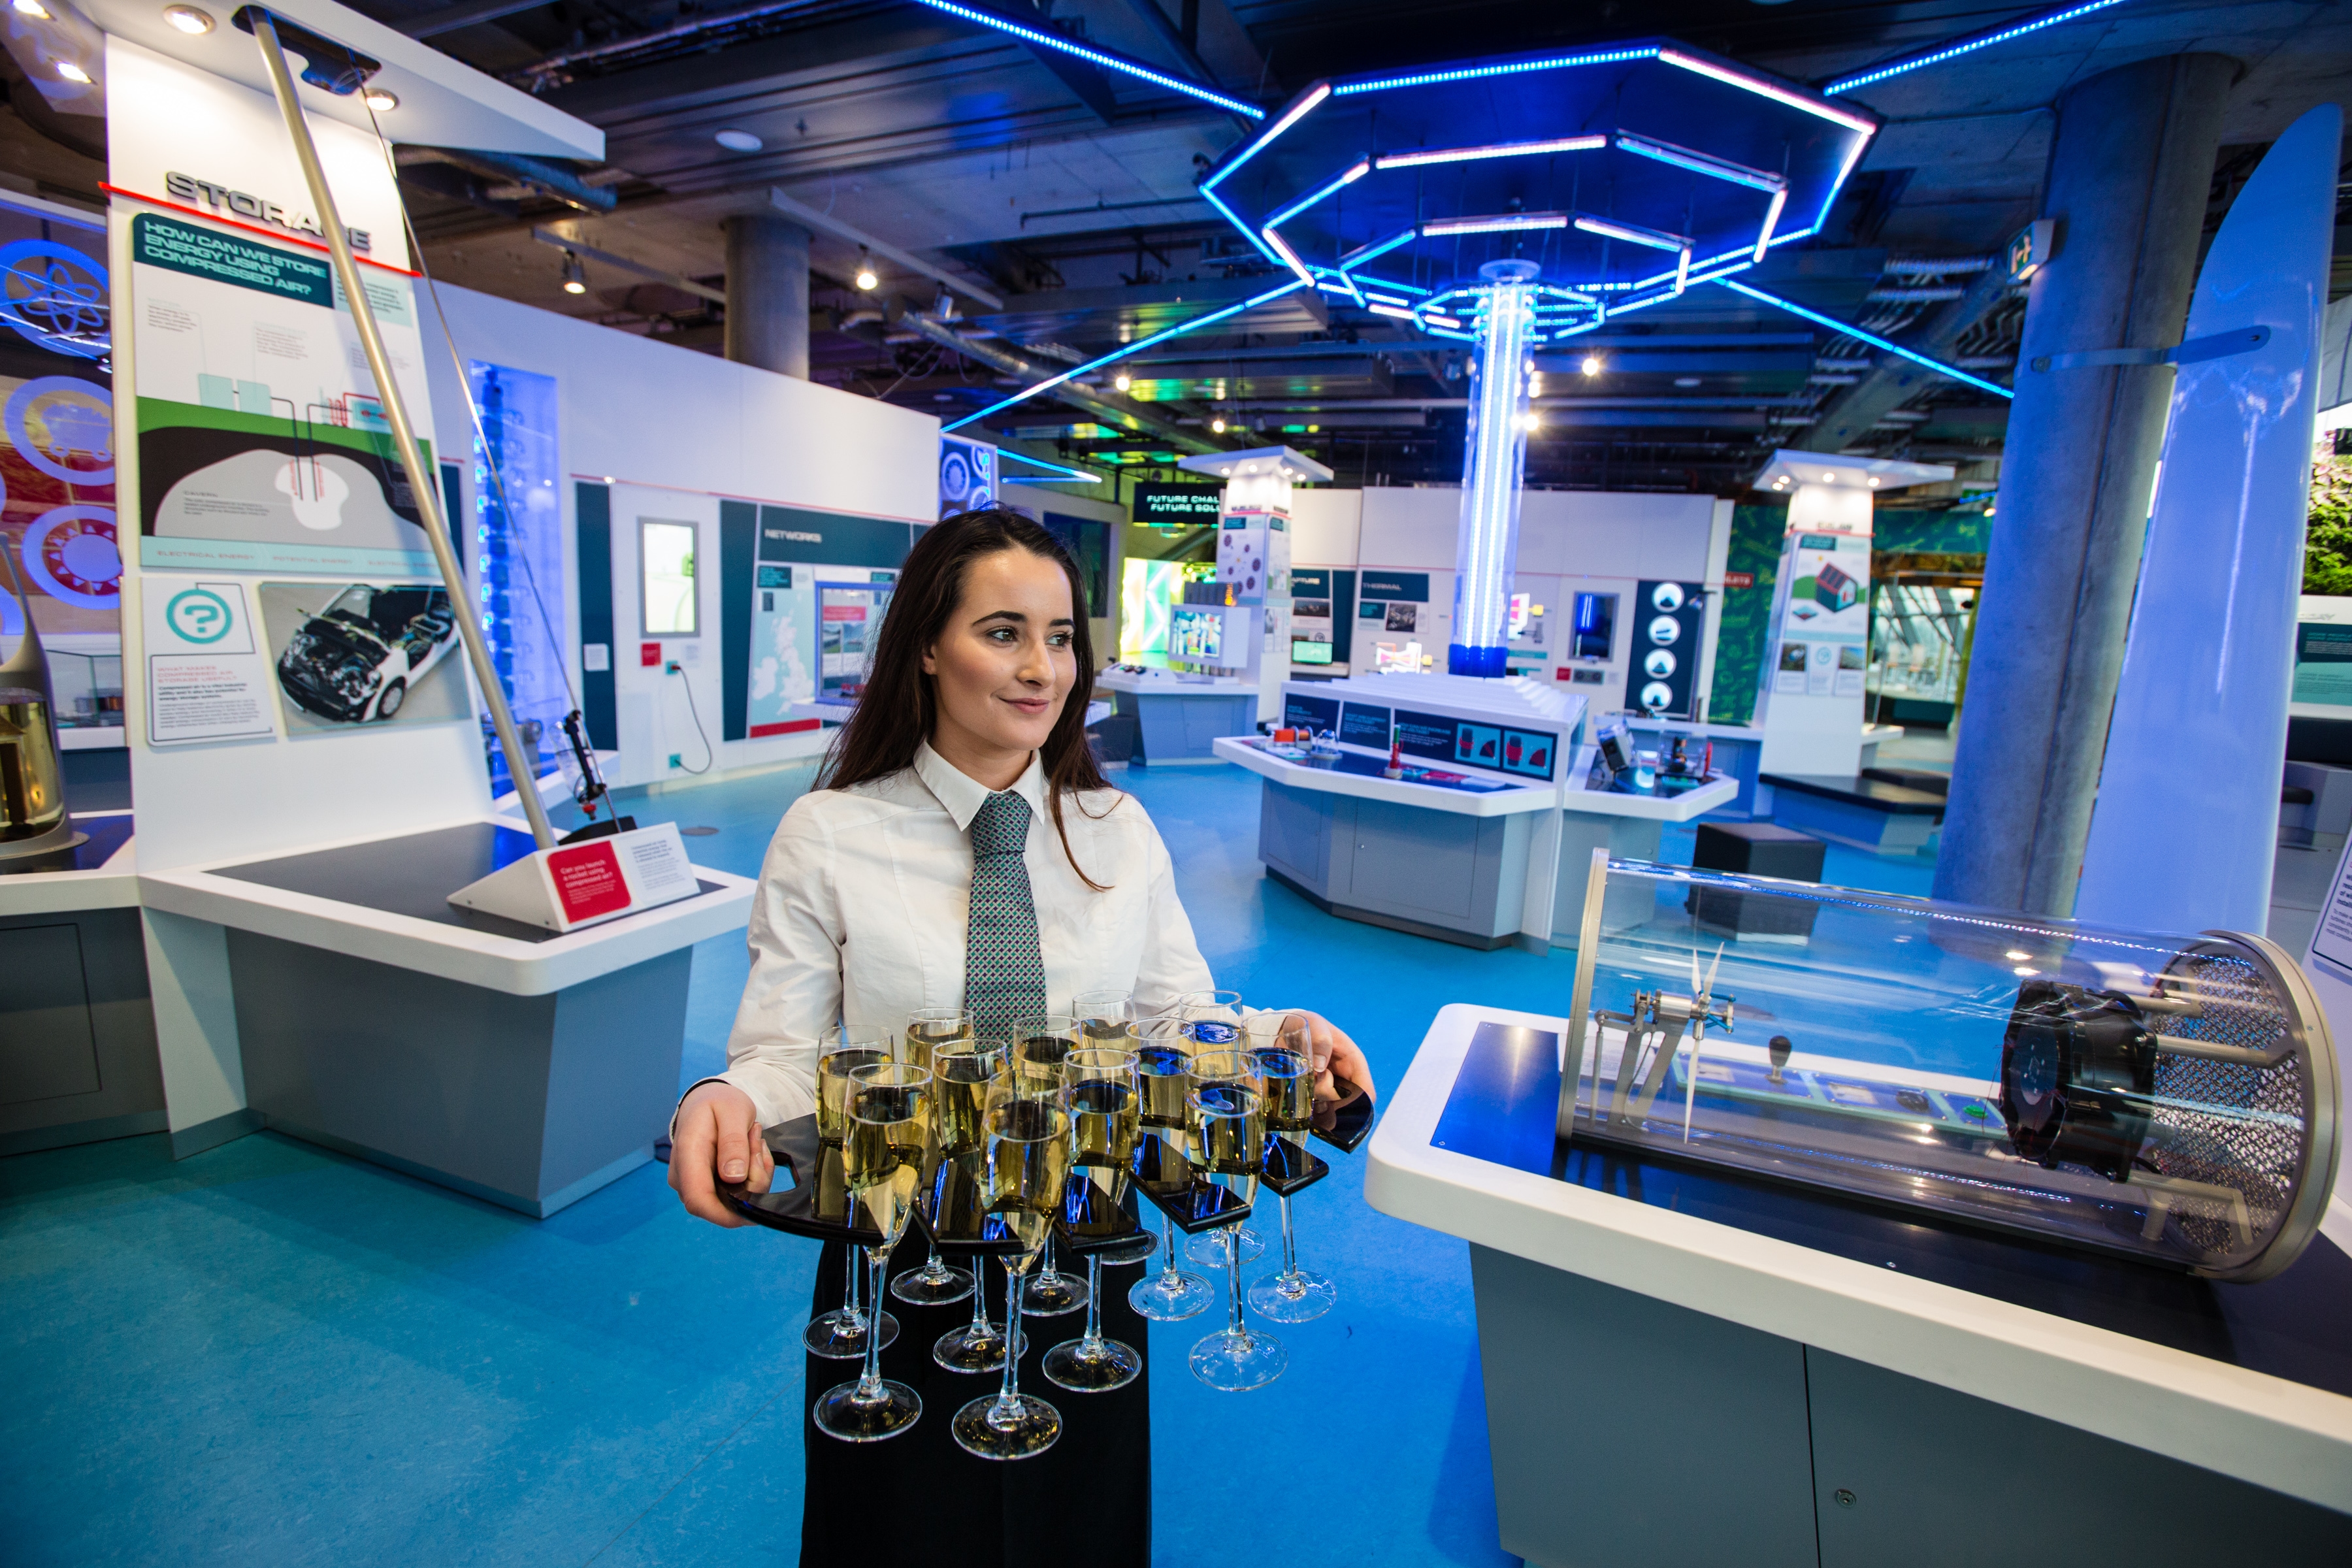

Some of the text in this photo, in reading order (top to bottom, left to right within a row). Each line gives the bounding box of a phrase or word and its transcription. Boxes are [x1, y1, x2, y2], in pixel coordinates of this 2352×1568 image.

[165, 171, 370, 251] STORAE
[144, 220, 327, 278] HOW CAN WE STORE
[144, 233, 280, 276] ENERGY USING
[144, 244, 274, 286] COMPRESSED
[274, 277, 312, 295] AIR?
[1190, 495, 1220, 504] CHAL
[1151, 503, 1192, 512] FUTURE
[764, 529, 822, 543] NETWORKS
[1363, 582, 1402, 591] THERMAL
[560, 866, 573, 875] Can
[585, 858, 606, 869] launch
[568, 870, 588, 879] rocket
[588, 866, 605, 876] using
[565, 874, 601, 889] compressed
